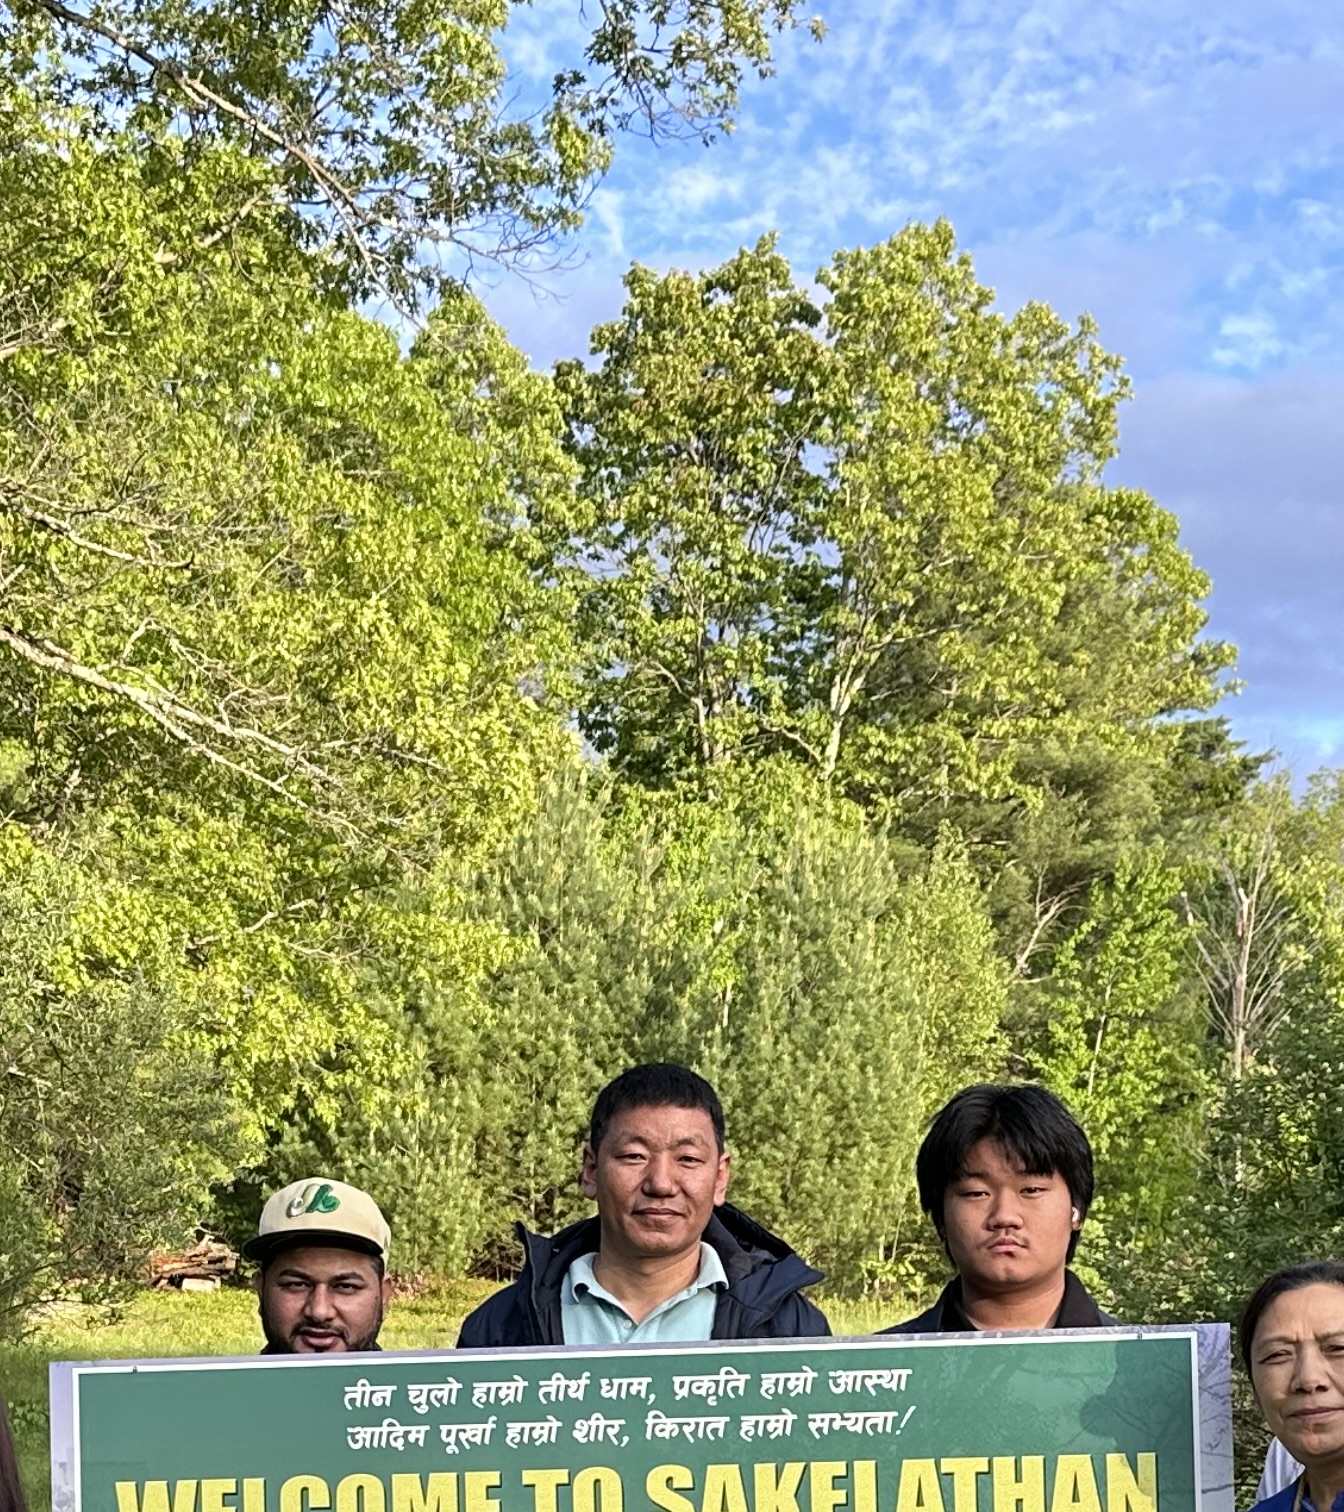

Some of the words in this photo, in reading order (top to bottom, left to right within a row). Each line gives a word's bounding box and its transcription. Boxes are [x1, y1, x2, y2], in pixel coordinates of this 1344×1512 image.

[344, 1378, 397, 1410] तीन
[407, 1377, 463, 1414] चुलो
[471, 1374, 529, 1408] हाम्रो
[538, 1371, 591, 1404] तीर्थ
[600, 1377, 656, 1405] धाम,
[672, 1366, 751, 1406] प्रकृति
[760, 1365, 819, 1400] हाम्रो
[828, 1368, 913, 1396] आस्था
[346, 1417, 430, 1451] आदिम
[505, 1415, 563, 1449] हाम्रो
[645, 1410, 730, 1444] किरात
[739, 1408, 798, 1442] हाम्रो
[808, 1405, 916, 1439] सभ्यता!
